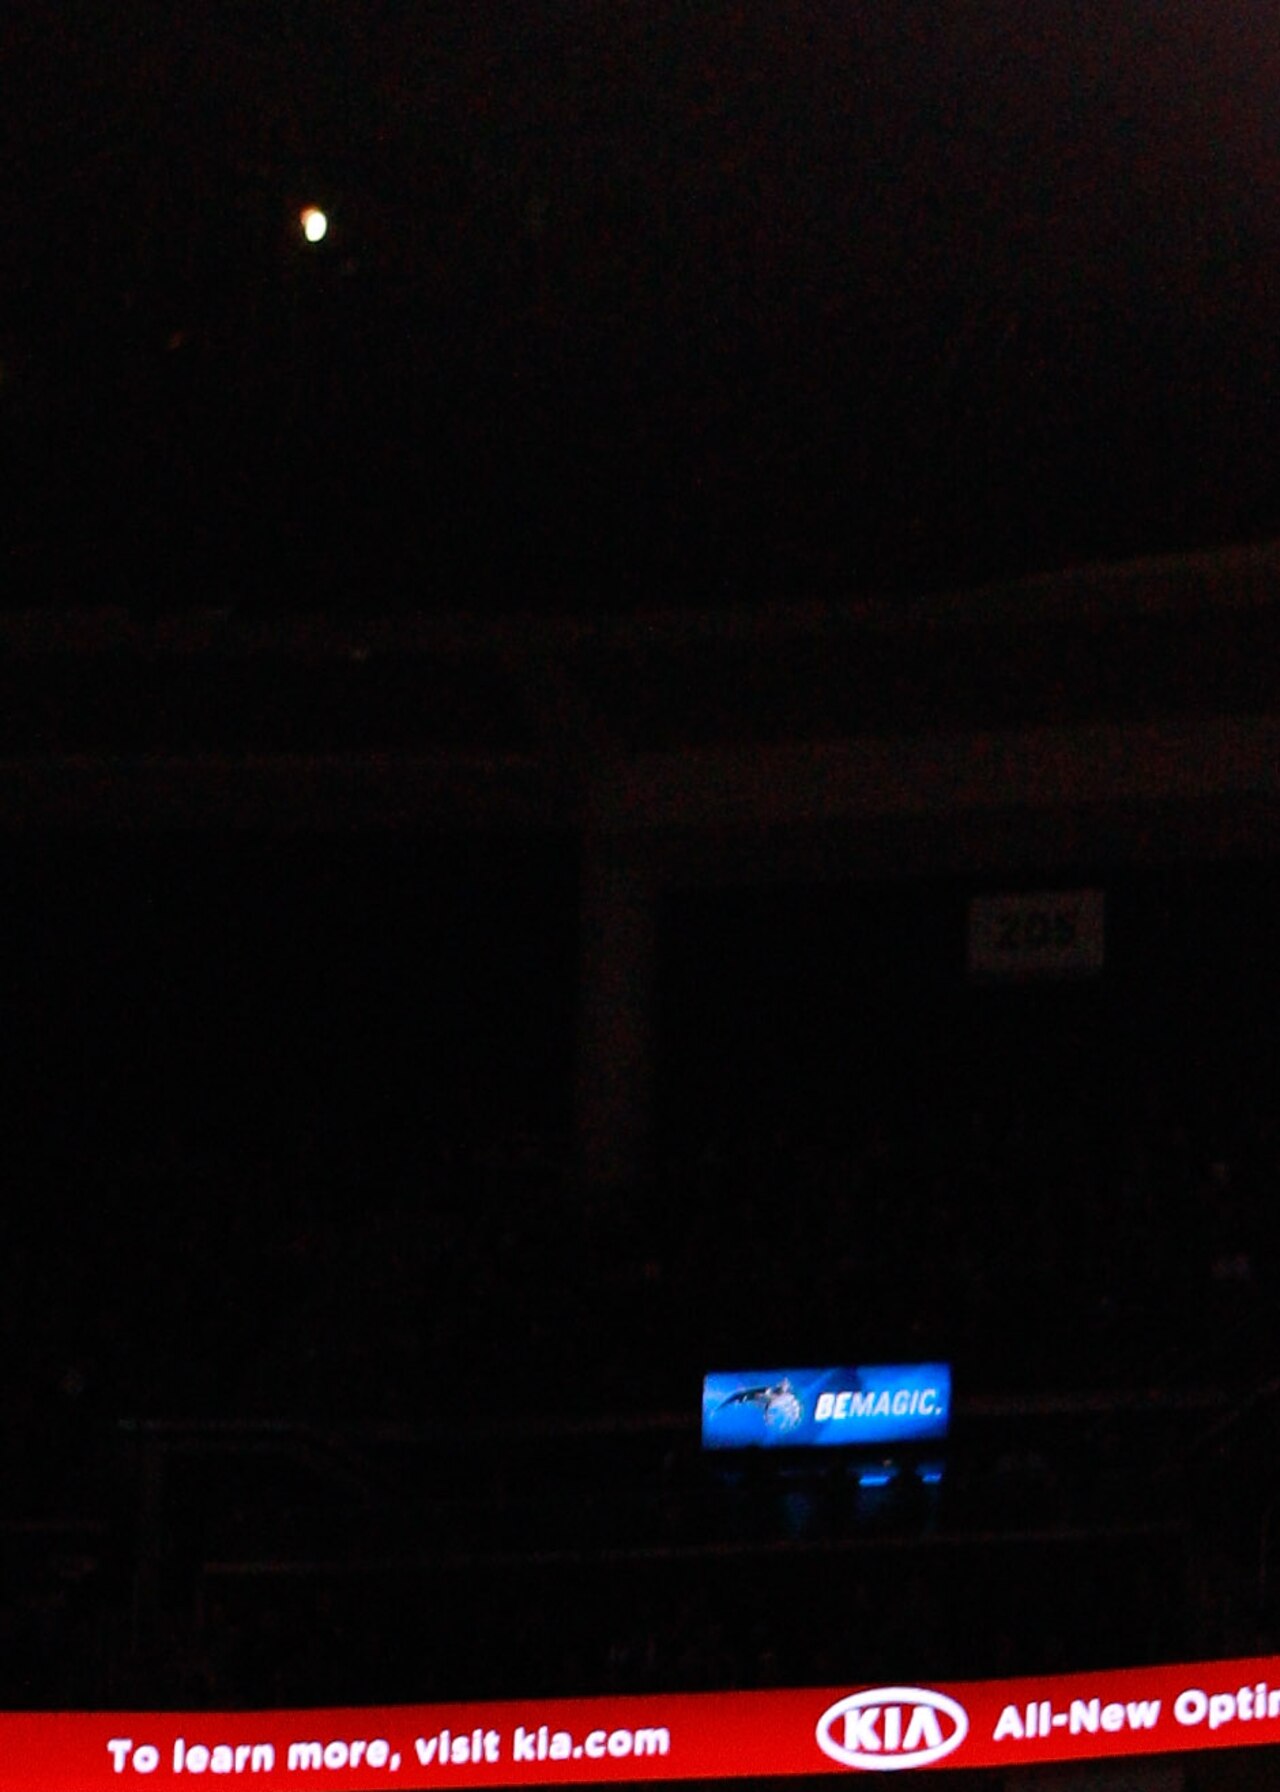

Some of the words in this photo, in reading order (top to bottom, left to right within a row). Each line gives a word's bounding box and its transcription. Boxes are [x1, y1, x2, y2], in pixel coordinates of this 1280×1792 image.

[844, 1704, 943, 1754] KIA
[992, 1698, 1161, 1741] All-New
[107, 1739, 160, 1773] To
[173, 1738, 275, 1774] learn
[287, 1739, 401, 1771] more,
[414, 1728, 500, 1766] visit
[513, 1725, 670, 1762] kia.com
